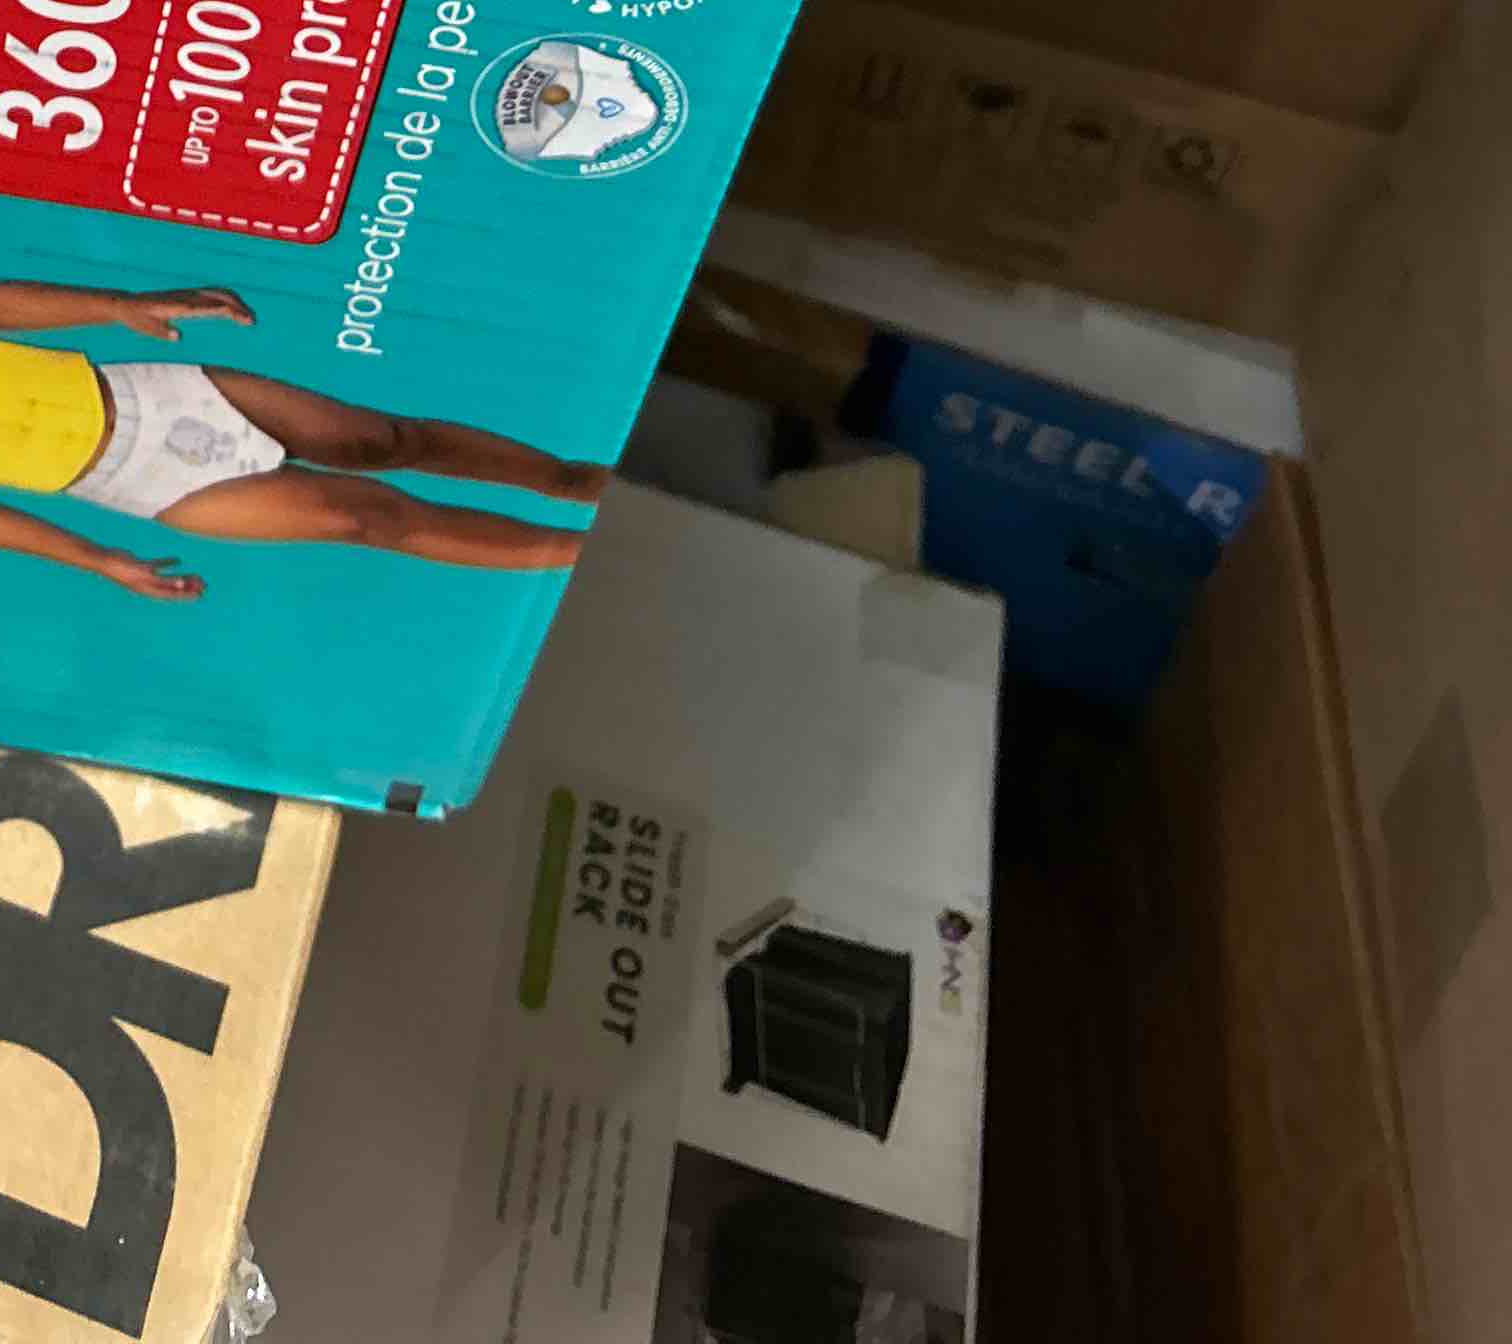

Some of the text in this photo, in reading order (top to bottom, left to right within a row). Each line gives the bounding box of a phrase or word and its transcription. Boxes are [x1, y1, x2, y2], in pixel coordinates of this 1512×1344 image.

[396, 62, 456, 100] la
[503, 63, 535, 124] BLOWOUT
[519, 70, 547, 123] BARRIER
[189, 105, 219, 133] TO
[244, 77, 329, 182] skin
[384, 110, 442, 160] de
[181, 136, 210, 165] UP
[335, 169, 424, 354] protection
[933, 391, 1155, 498] STEEL
[570, 799, 621, 926] RACK
[600, 816, 661, 1046] SLIDE OUT
